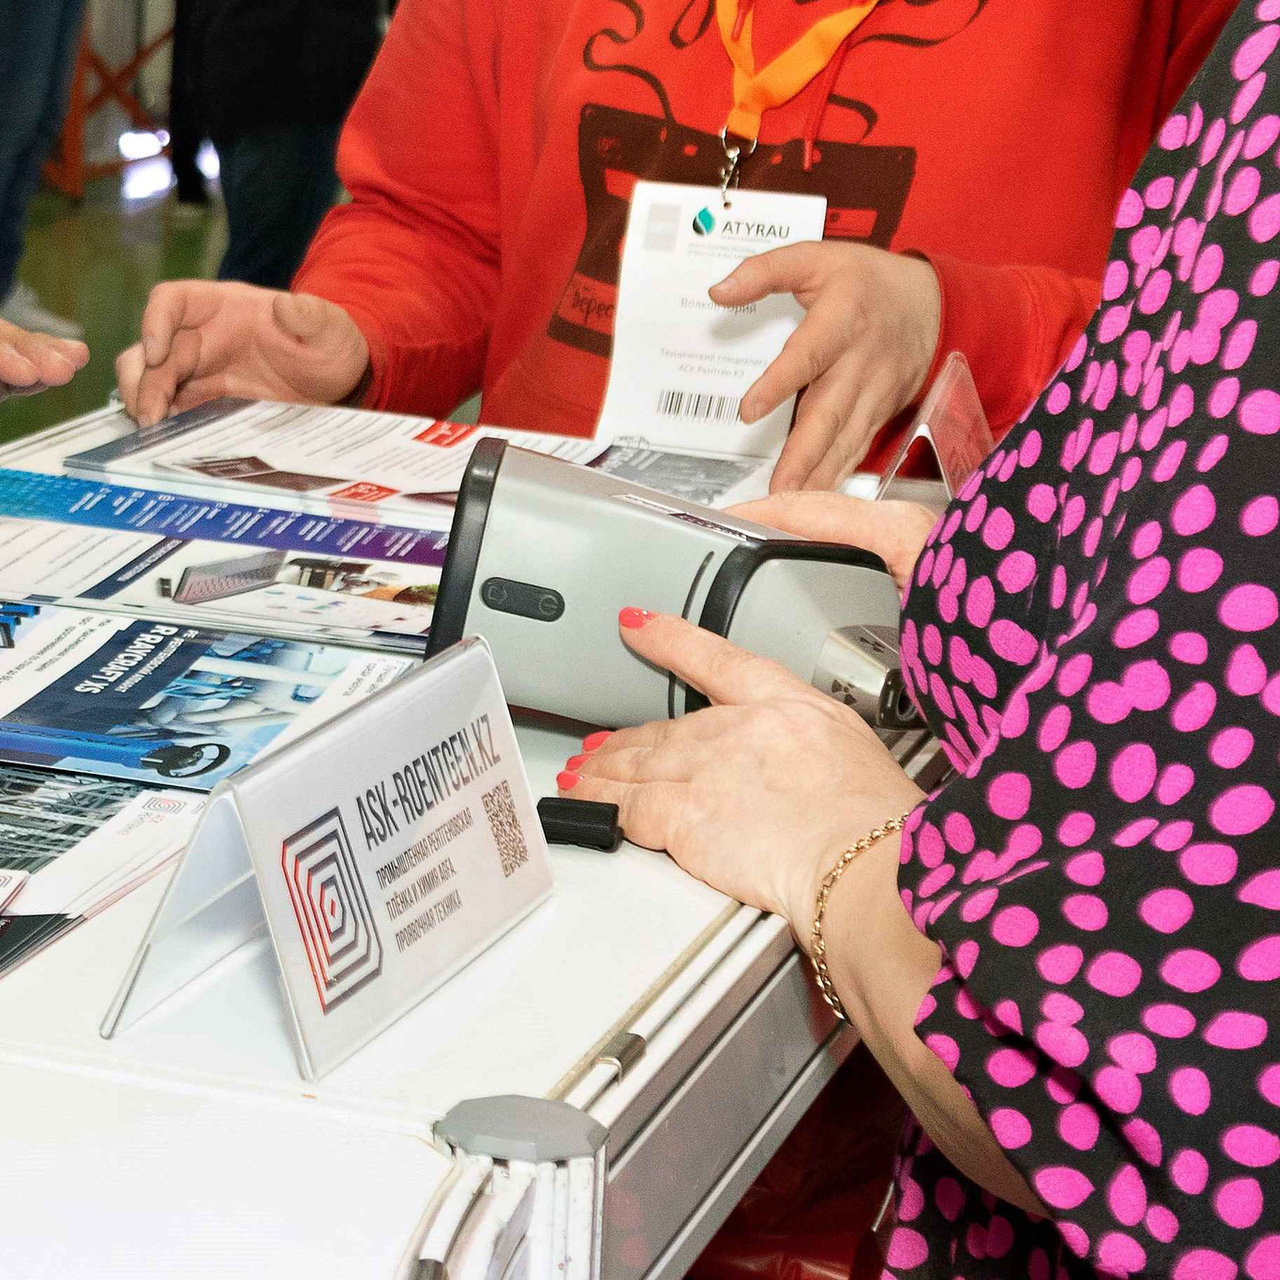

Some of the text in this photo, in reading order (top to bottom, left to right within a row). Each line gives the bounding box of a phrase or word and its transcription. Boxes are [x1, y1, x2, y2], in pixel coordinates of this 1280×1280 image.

[722, 219, 790, 240] ATYRAU
[72, 633, 166, 694] RAYCRAFT XS
[356, 713, 501, 851] ASK-ROENTGEN.KZ
[376, 807, 474, 890] ПРОМЫШЛЕННАЯ РЕНТГЕНОВСКАЯ
[386, 887, 415, 921] ПЛЁНКА
[417, 868, 441, 899] ХИМИЯ
[395, 889, 463, 953] ПРОЯВОЧНАЯ ТЕХНИКА
